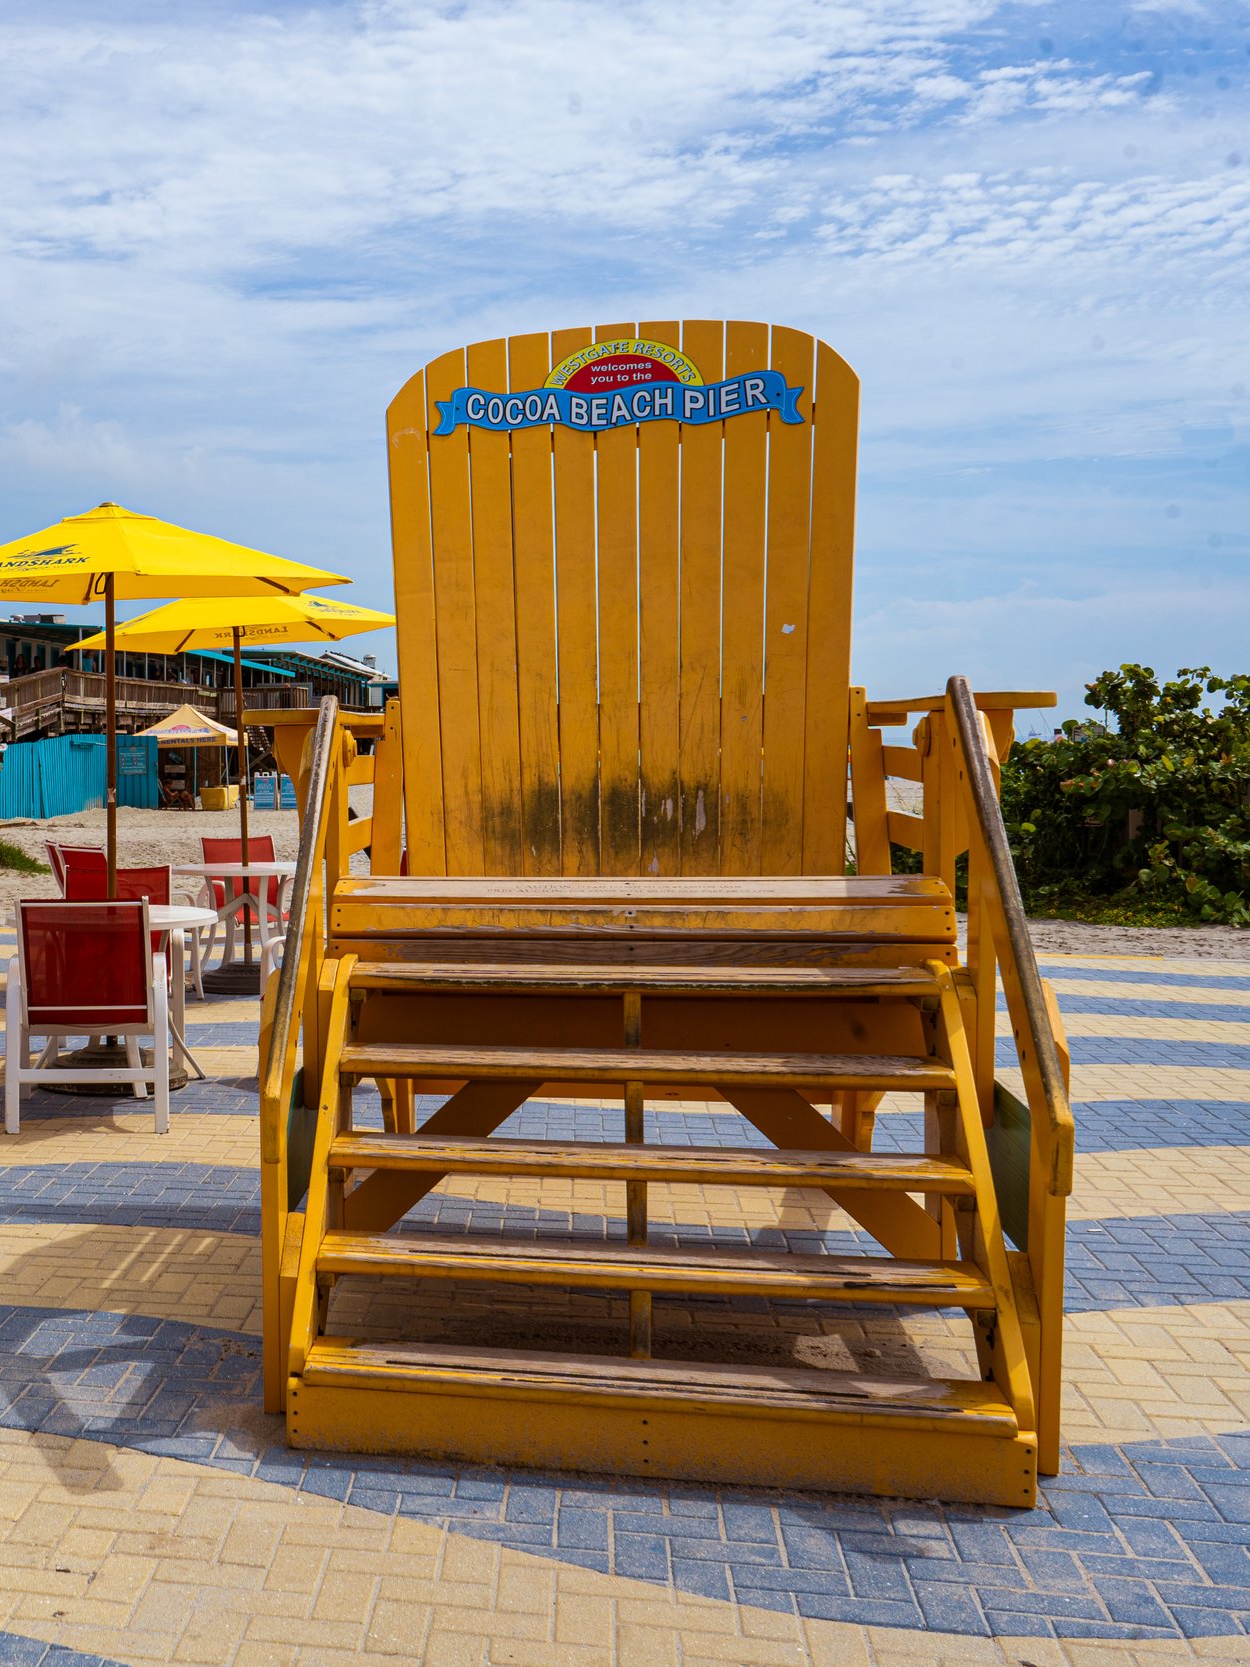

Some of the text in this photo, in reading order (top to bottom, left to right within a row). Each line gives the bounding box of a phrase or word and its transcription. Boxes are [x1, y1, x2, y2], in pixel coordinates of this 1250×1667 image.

[550, 341, 696, 386] WESTGATE RESORTS
[590, 361, 652, 372] welcomes
[590, 375, 614, 385] you
[632, 372, 652, 381] the
[466, 378, 768, 426] COCOA BEACH PIER
